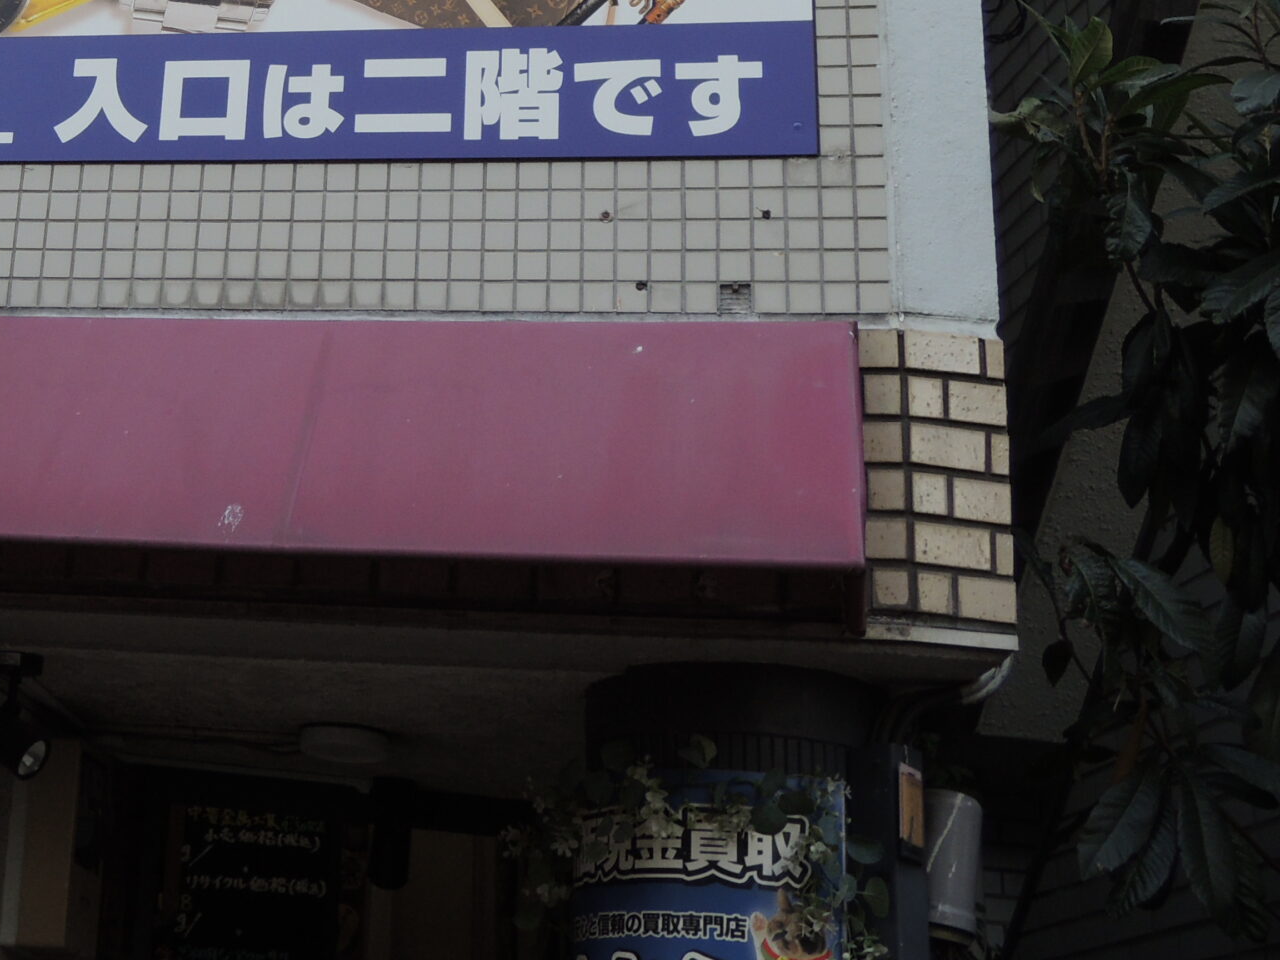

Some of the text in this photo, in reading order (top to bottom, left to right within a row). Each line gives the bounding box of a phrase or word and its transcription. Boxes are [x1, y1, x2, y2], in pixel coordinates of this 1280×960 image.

[53, 47, 764, 144] 入口は二階です
